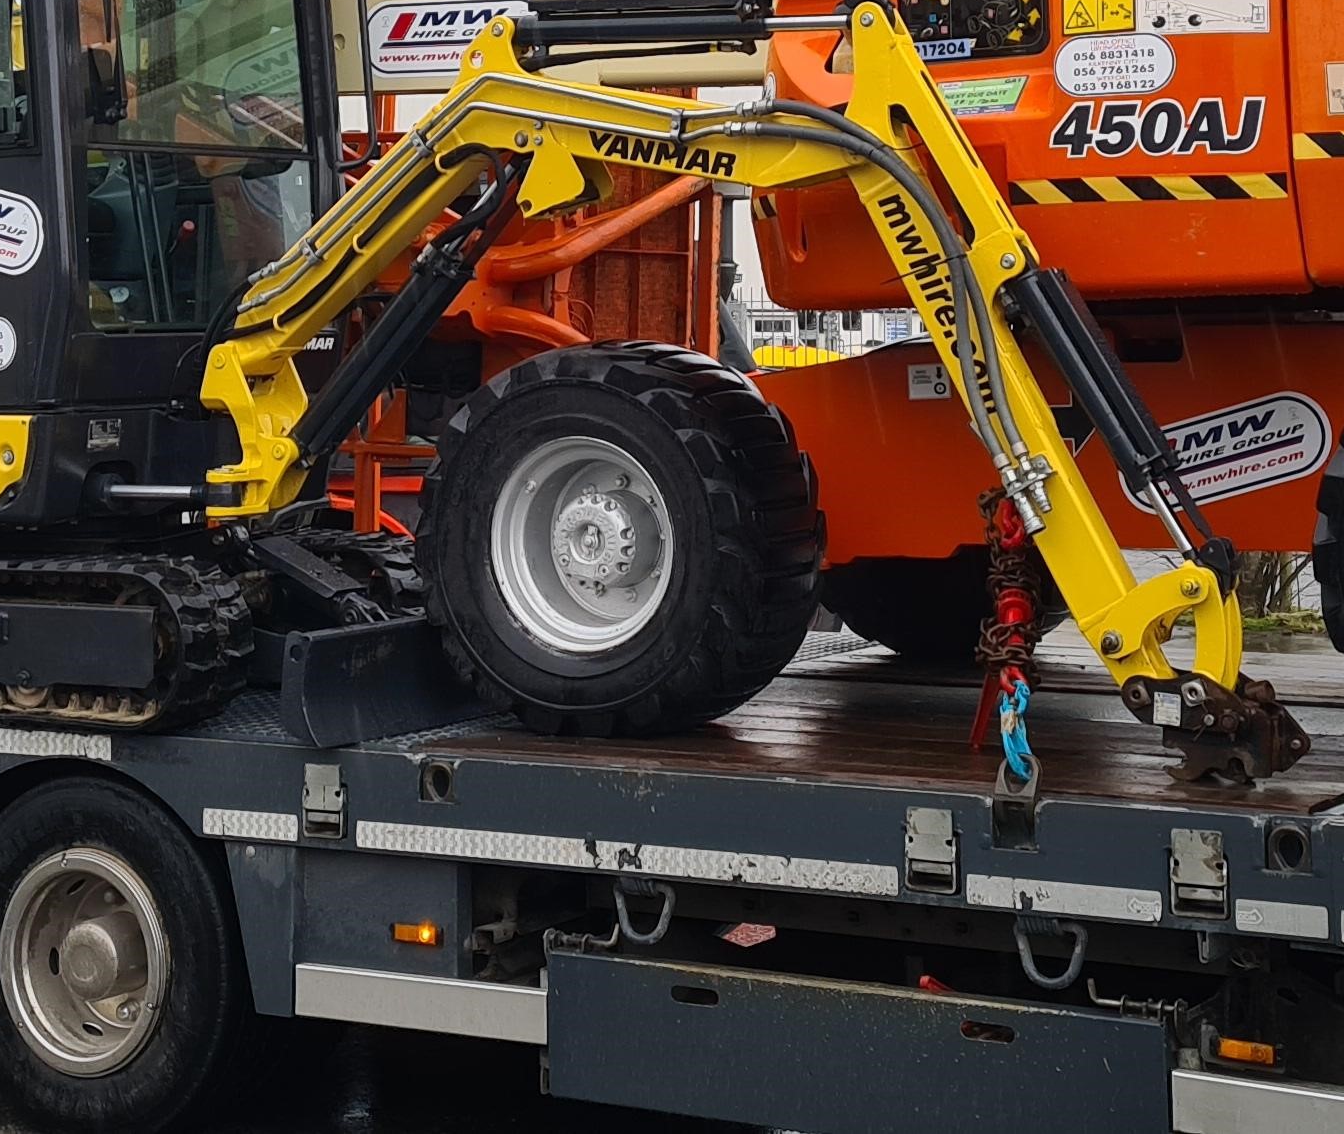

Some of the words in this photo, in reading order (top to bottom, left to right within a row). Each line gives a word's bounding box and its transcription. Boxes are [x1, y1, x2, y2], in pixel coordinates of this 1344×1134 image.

[418, 8, 509, 27] MW
[411, 29, 456, 39] HIRE
[1073, 52, 1096, 62] 056
[1100, 48, 1155, 60] 8831418
[1073, 67, 1096, 77] 056
[1100, 64, 1155, 75] 7761265
[1073, 82, 1096, 92] 053
[1100, 80, 1155, 91] 9168122
[1049, 97, 1266, 158] 450AJ
[588, 130, 737, 178] YANMAR
[303, 337, 335, 351] MAR
[1183, 409, 1275, 452] MW
[1177, 445, 1226, 465] HIRE
[1232, 423, 1304, 452] GROUP
